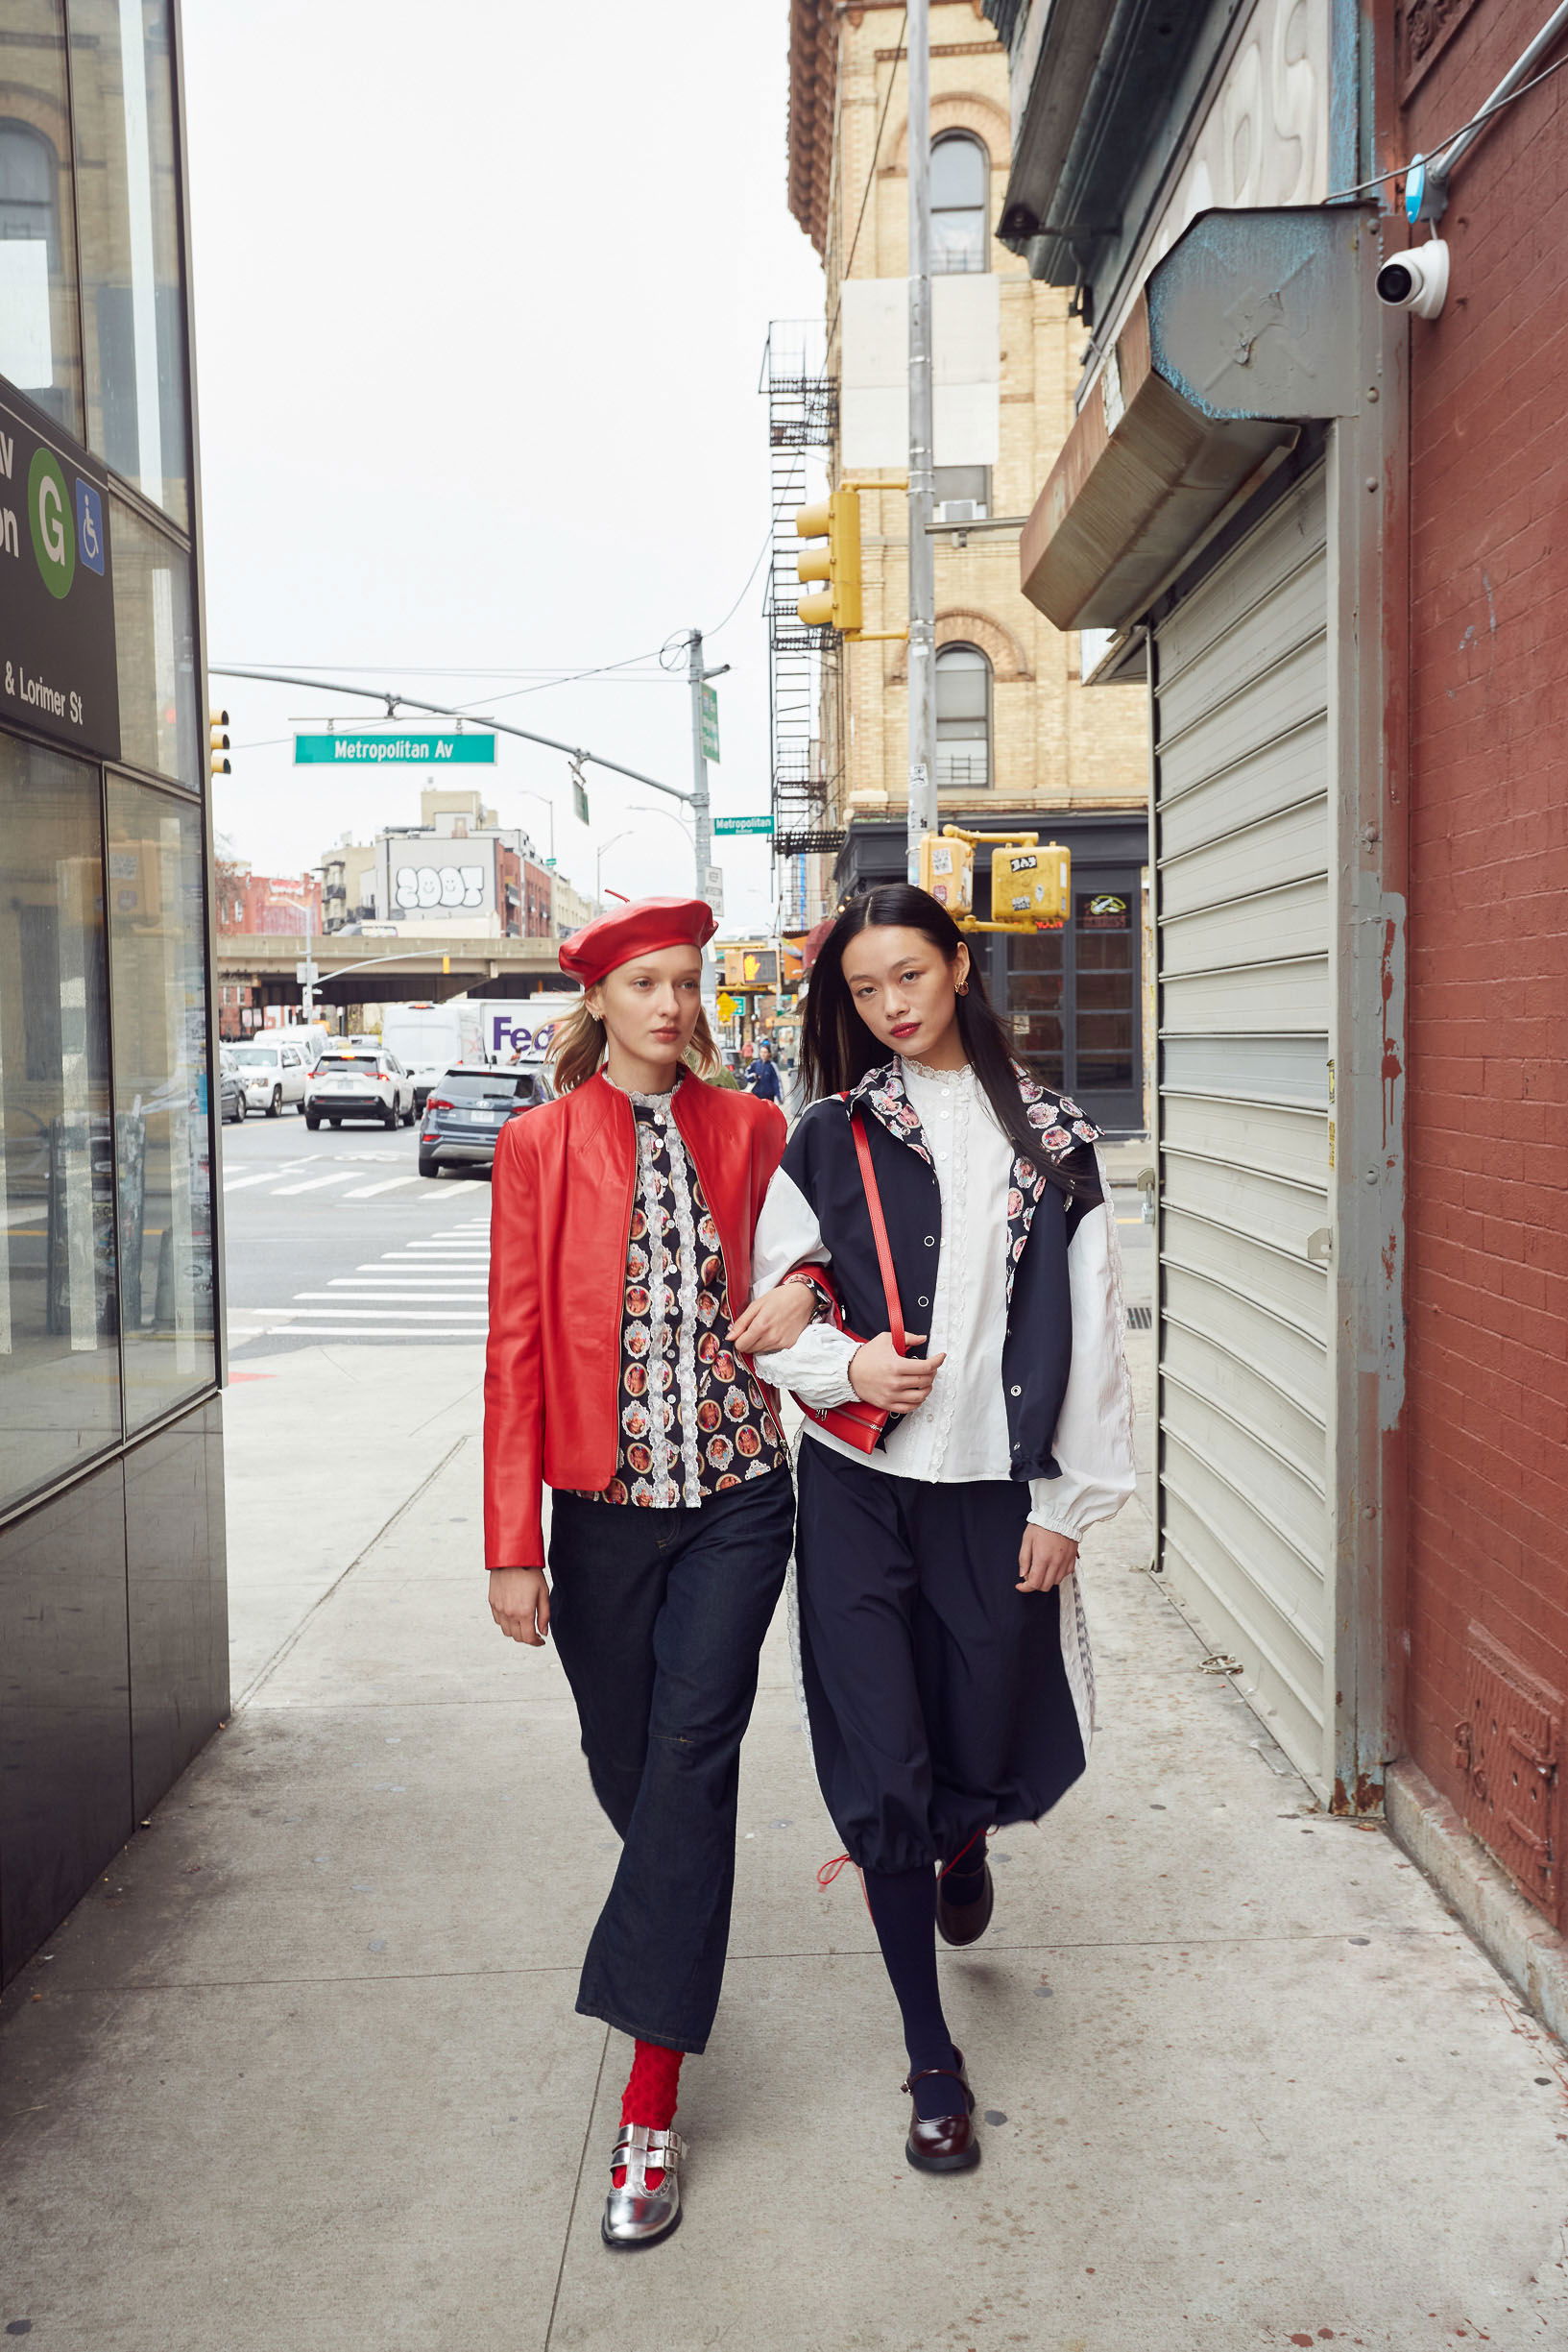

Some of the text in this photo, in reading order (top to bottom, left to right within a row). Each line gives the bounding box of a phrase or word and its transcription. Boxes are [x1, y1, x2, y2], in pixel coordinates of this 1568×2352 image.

[38, 475, 65, 567] G
[5, 662, 84, 725] & Lorimer St
[334, 740, 454, 762] Metropolitan Av
[715, 817, 771, 830] Metropolitan
